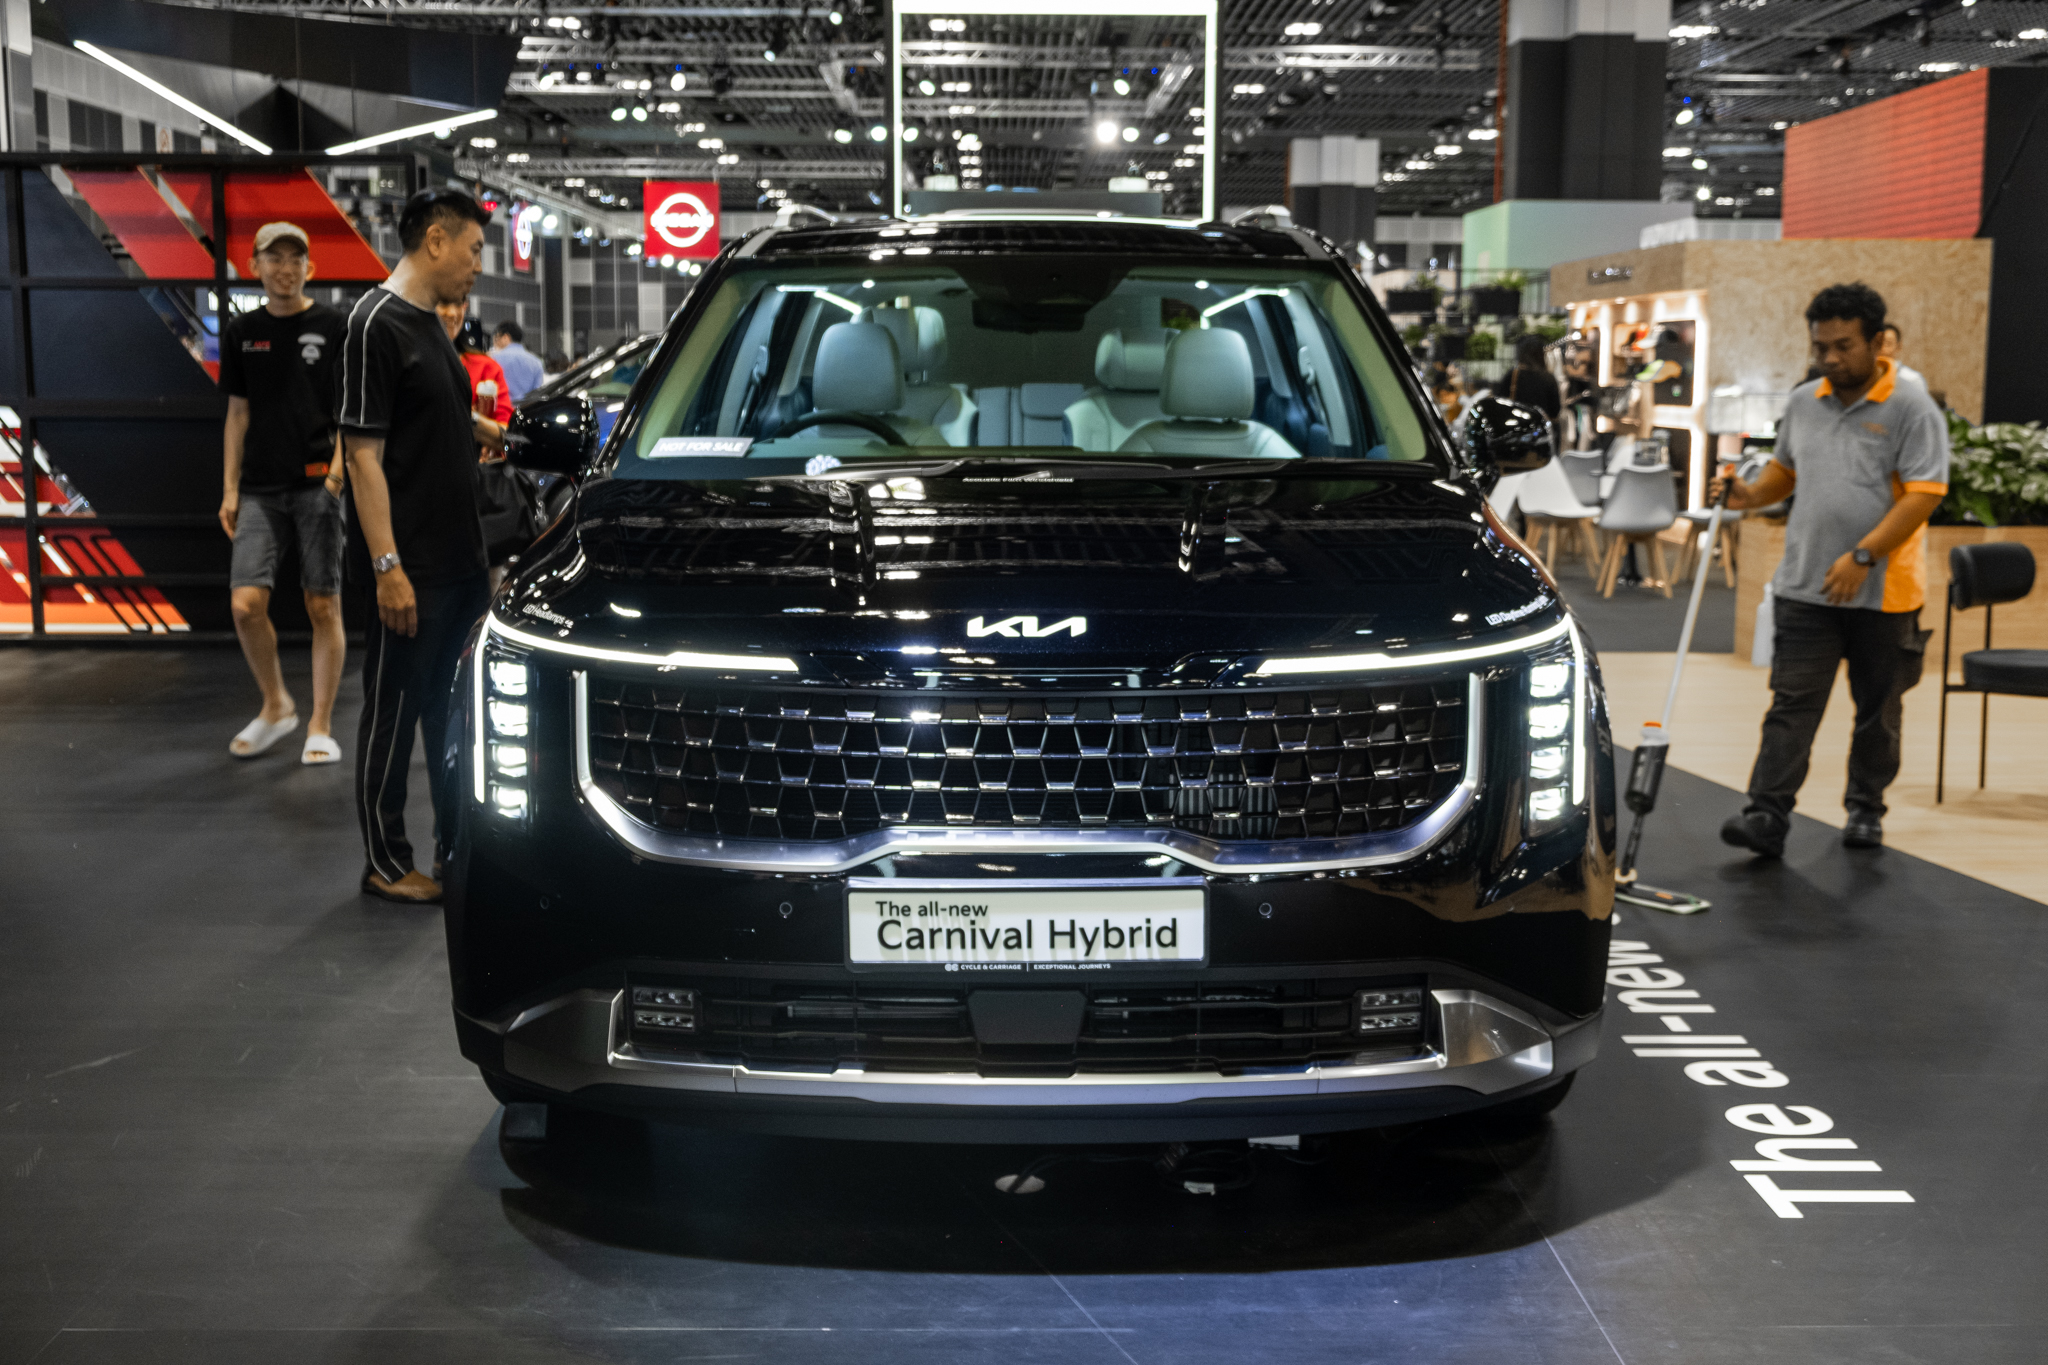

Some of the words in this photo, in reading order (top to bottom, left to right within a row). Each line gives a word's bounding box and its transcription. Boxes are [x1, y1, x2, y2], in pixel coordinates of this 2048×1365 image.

[659, 442, 686, 452] NOT
[686, 442, 714, 452] FOR
[712, 442, 744, 452] SALE
[967, 616, 1087, 638] KIA
[1485, 613, 1502, 626] LED
[876, 901, 911, 917] The
[918, 901, 988, 917] all-new
[877, 919, 1032, 950] Carnival
[1049, 917, 1177, 957] Hybrid
[1725, 1103, 1916, 1219] The
